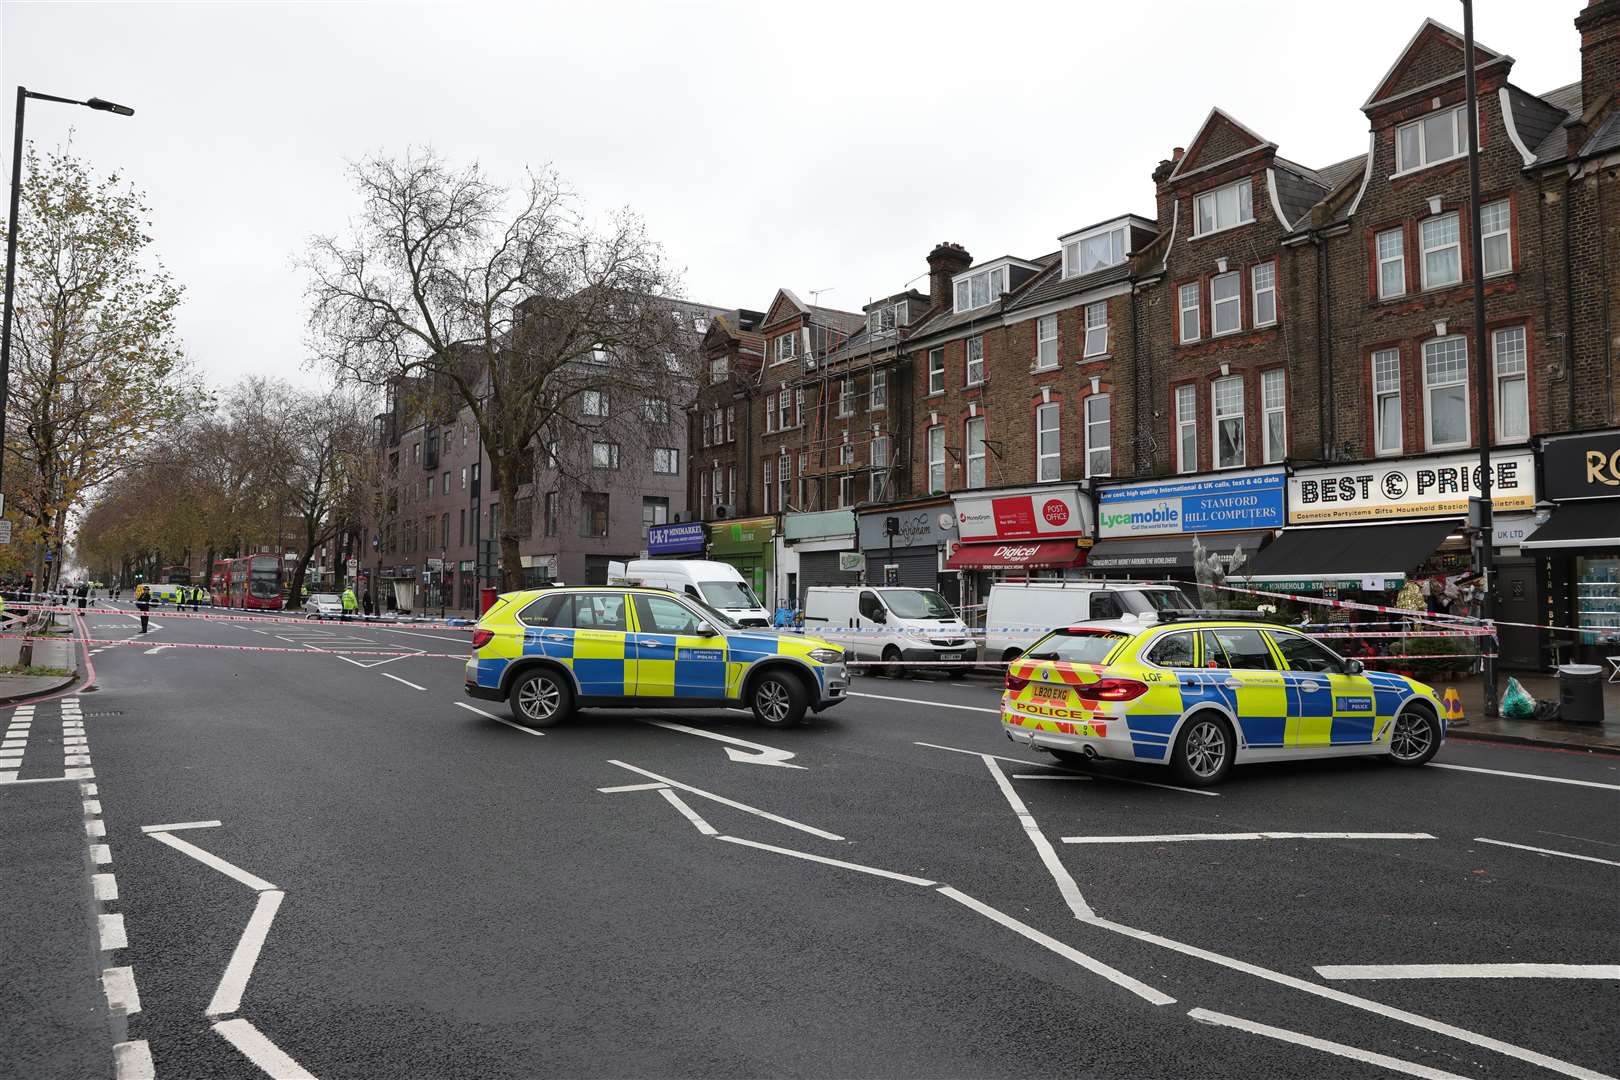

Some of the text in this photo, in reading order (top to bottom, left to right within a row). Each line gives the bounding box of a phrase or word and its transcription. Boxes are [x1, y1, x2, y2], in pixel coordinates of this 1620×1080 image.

[1302, 475, 1374, 503] BEST
[1417, 462, 1518, 495] PRICE
[1160, 484, 1197, 493] International
[1200, 496, 1258, 509] STAMFORD
[1048, 504, 1063, 513] POST
[1397, 504, 1435, 513] Household
[1046, 512, 1068, 521] OFFICE
[1101, 507, 1178, 528] Lycamobile
[1185, 507, 1276, 522] HILL COMPUTERS
[1498, 530, 1523, 539] UK LTD
[993, 545, 1040, 560] Digicel
[1269, 582, 1305, 590] HOUSEHOLD
[1143, 673, 1162, 681] LQF
[1034, 686, 1067, 700] LB20 EXG
[1017, 703, 1082, 719] POLICE
